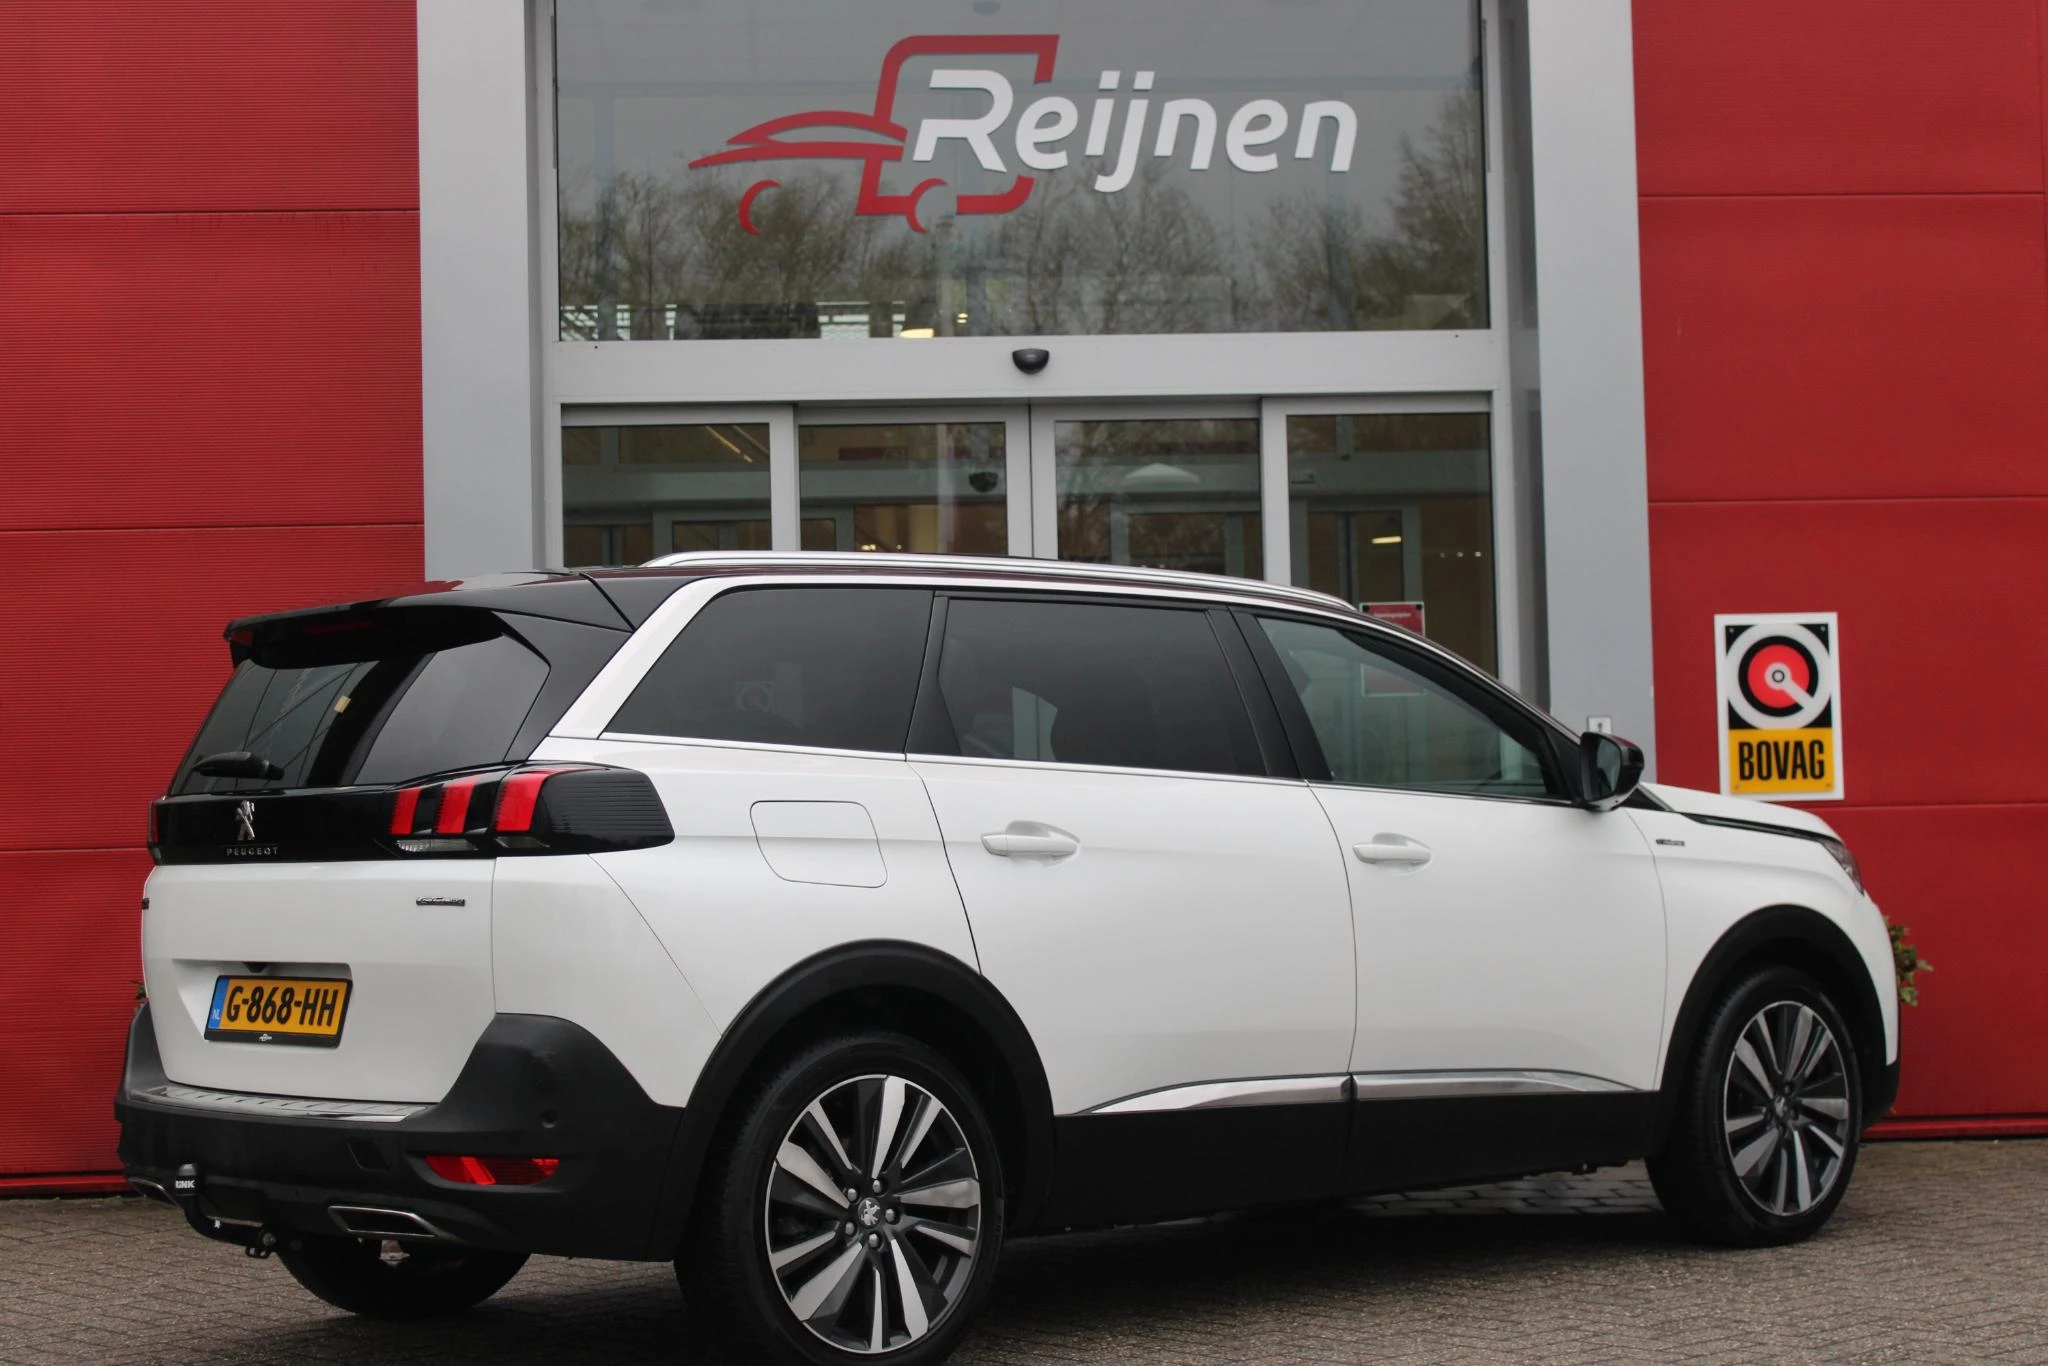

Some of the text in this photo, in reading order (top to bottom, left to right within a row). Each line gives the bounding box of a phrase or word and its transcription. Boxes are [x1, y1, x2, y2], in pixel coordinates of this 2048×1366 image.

[912, 69, 1358, 193] Reijnen
[1738, 740, 1825, 781] BOVAG
[226, 847, 279, 856] PEUGEOT
[211, 1008, 221, 1020] NL
[226, 985, 339, 1027] G-868-HH
